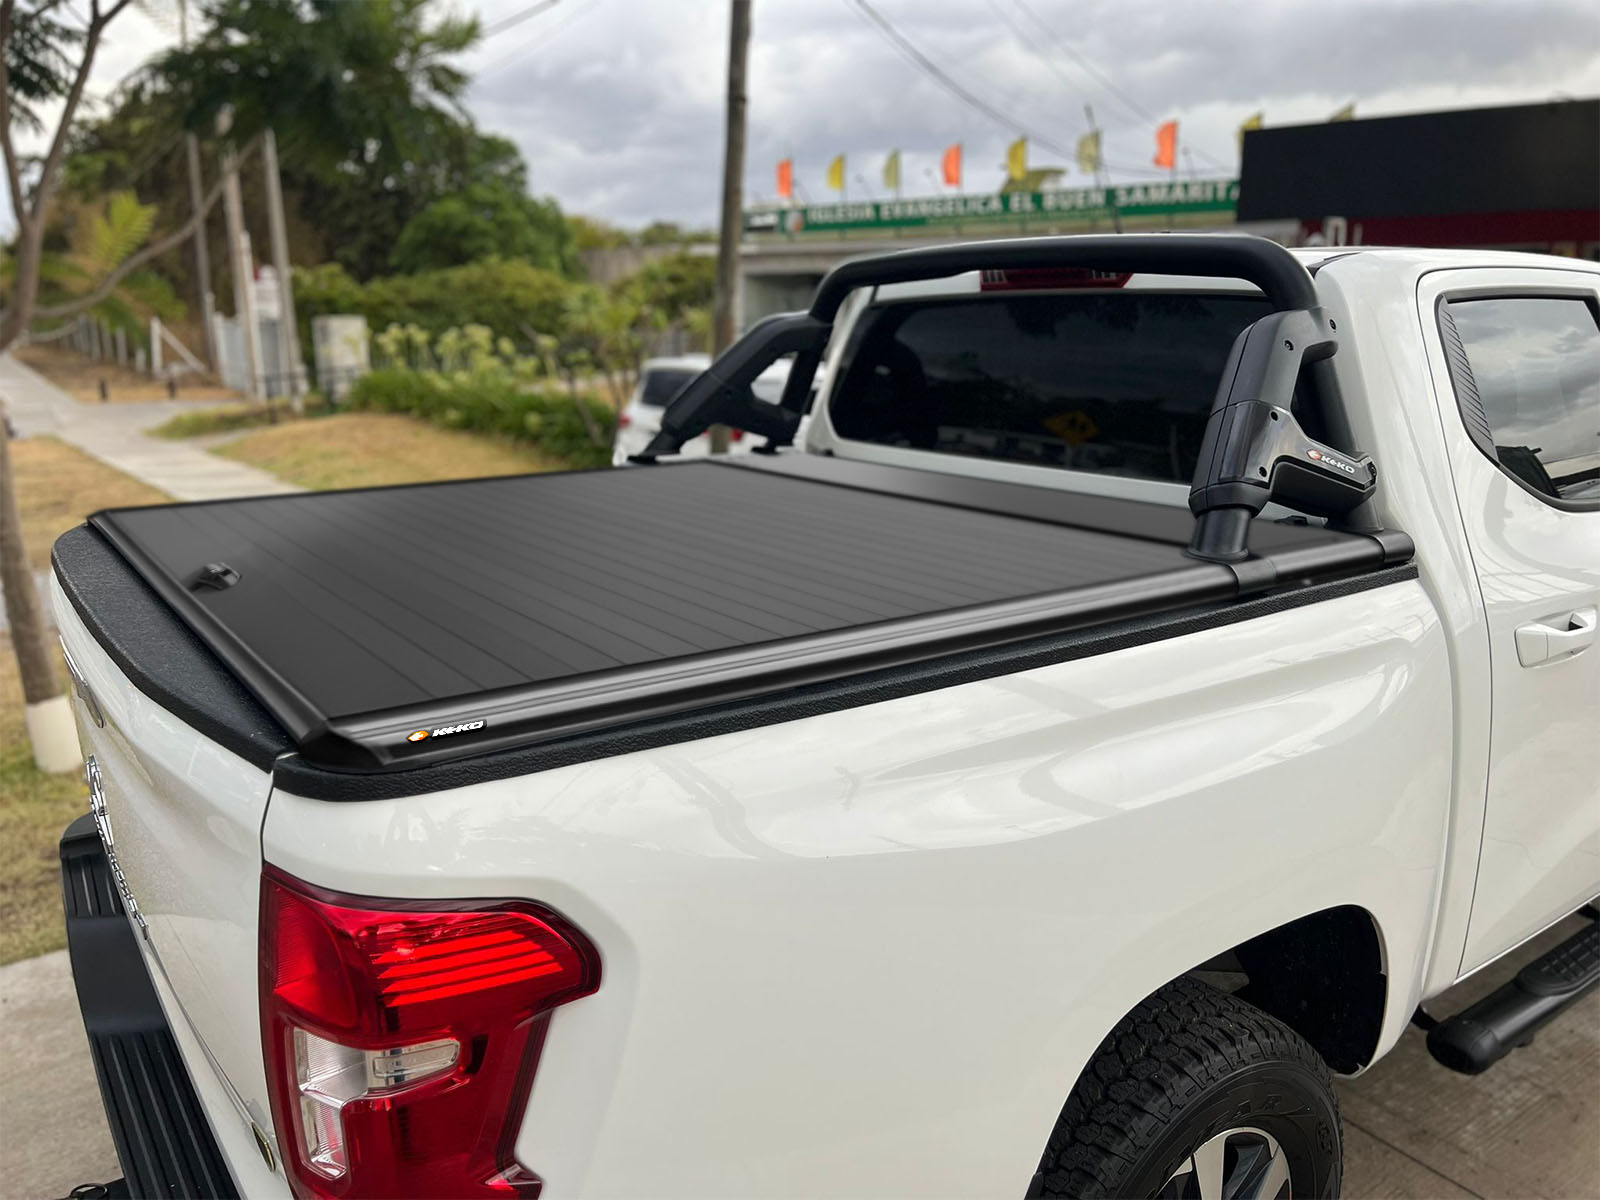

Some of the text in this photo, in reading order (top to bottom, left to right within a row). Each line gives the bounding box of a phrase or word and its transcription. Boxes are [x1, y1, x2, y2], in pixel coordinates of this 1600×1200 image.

[806, 203, 877, 225] IGLESIA
[1009, 191, 1034, 213] EL
[1041, 188, 1107, 211] BUEN
